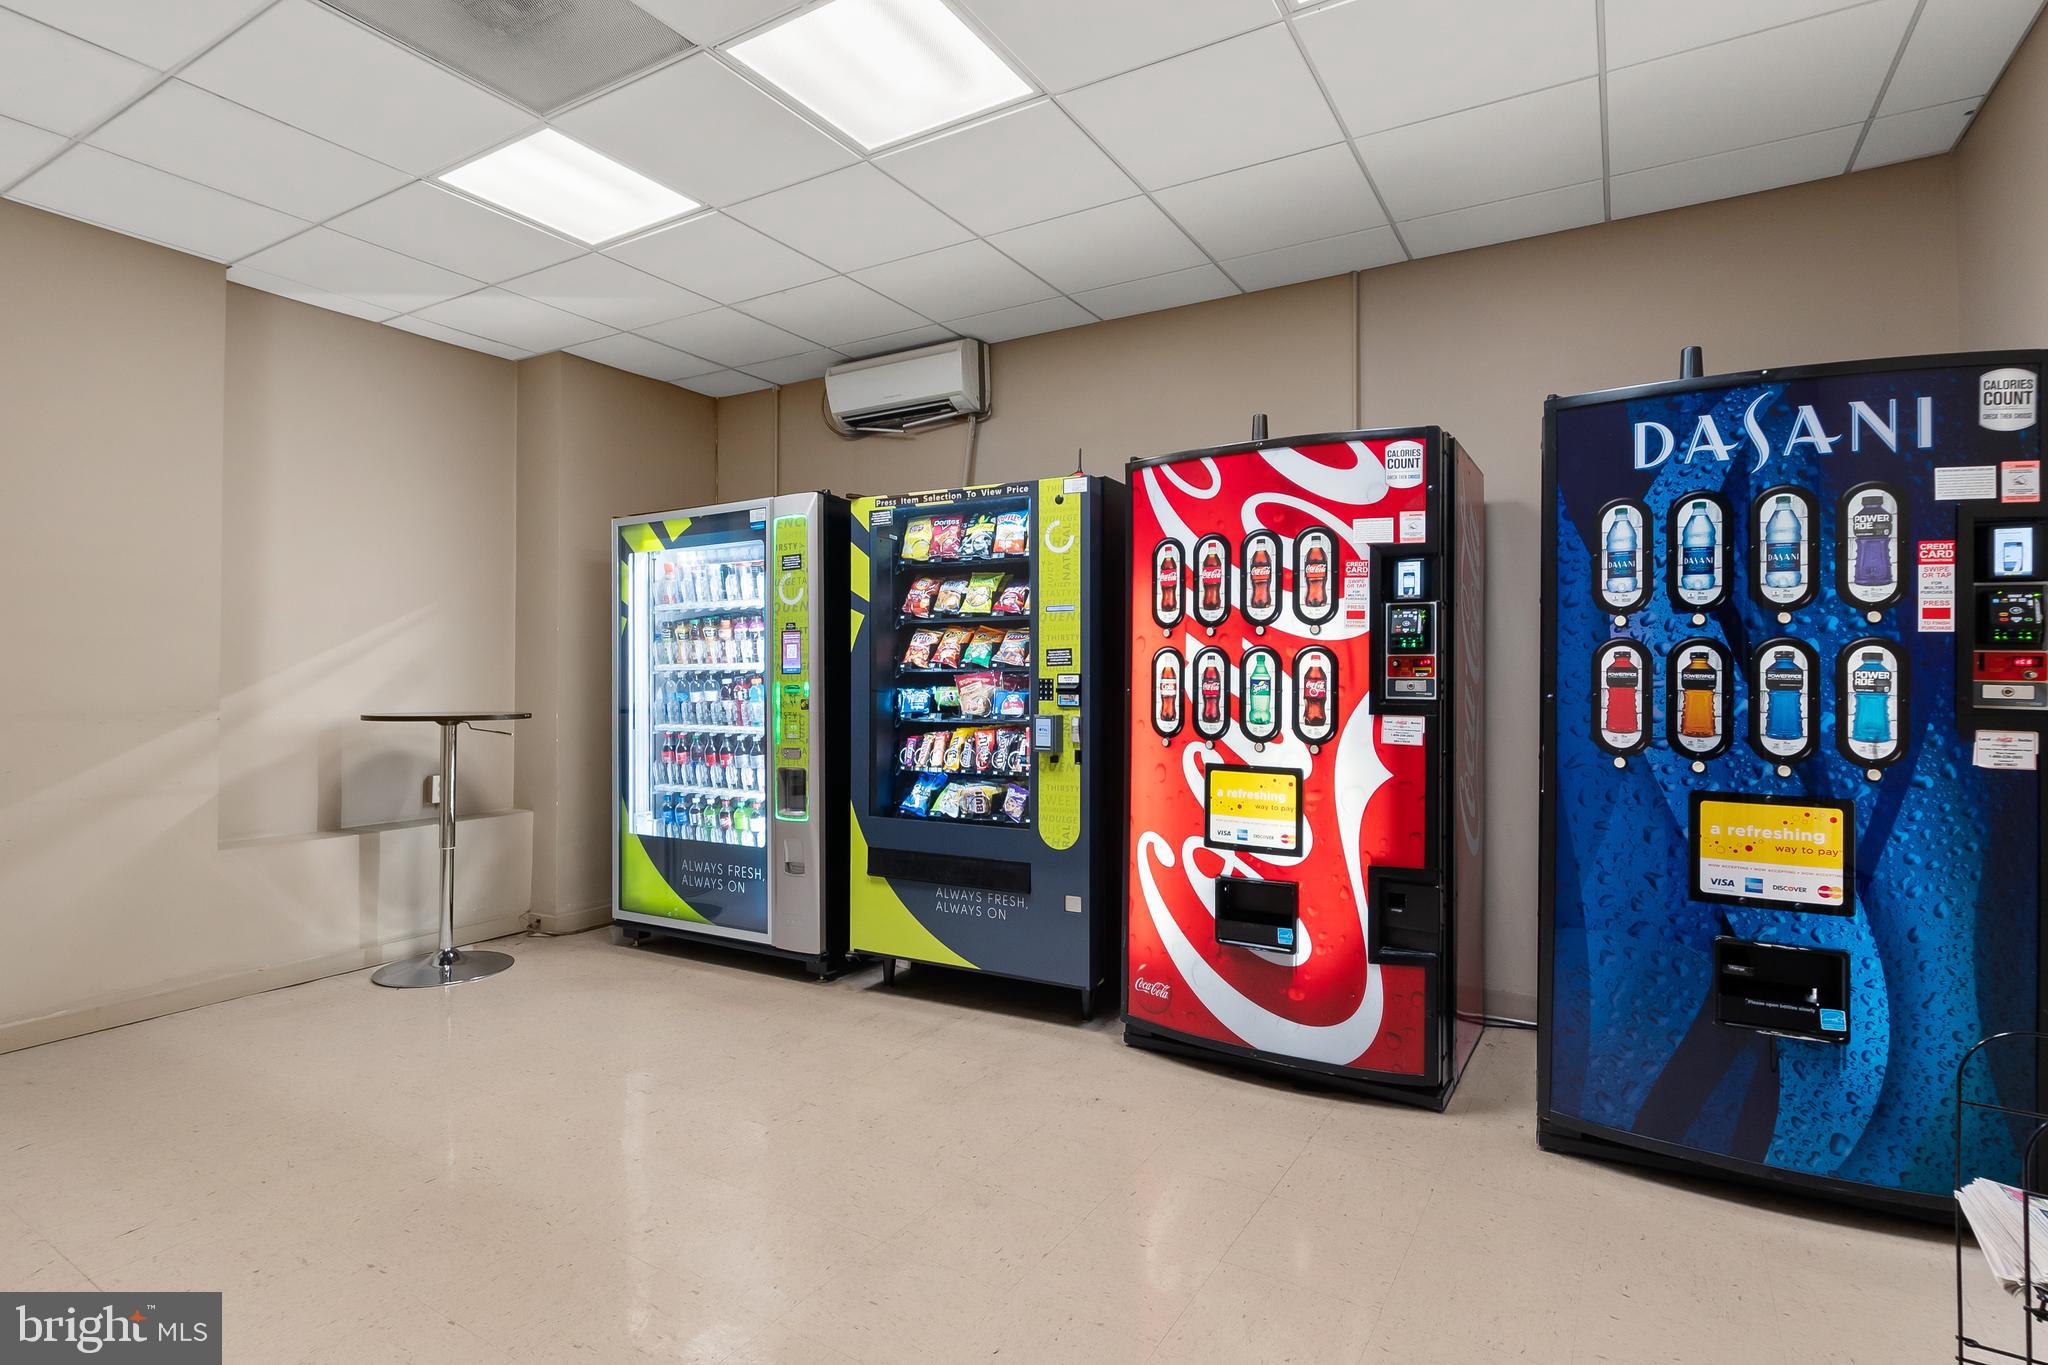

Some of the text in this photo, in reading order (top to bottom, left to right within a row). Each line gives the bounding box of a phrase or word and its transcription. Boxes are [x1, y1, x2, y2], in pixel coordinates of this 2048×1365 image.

[1984, 379, 2033, 390] CALORIES
[1984, 391, 2033, 406] COUNT
[1634, 391, 1932, 474] DASANI
[1387, 449, 1421, 457] CALORIES
[1387, 458, 1421, 469] COUNT
[876, 499, 896, 507] Press
[901, 497, 918, 505] Item
[923, 493, 962, 503] Selection
[981, 489, 1002, 497] View
[1006, 485, 1029, 494] Price
[1854, 514, 1889, 522] POWER
[1684, 556, 1713, 565] DASANI
[1768, 553, 1799, 561] DASANI
[1920, 550, 1954, 559] CARD
[1608, 560, 1635, 569] DASANI
[1855, 671, 1890, 680] POWER
[1217, 788, 1287, 803] a refreshing
[1711, 824, 1826, 845] a refreshing
[1775, 845, 1839, 857] way to pay
[681, 859, 765, 882] ALWAYS FRESH,
[681, 875, 745, 893] ALWAYS ON
[1711, 877, 1735, 887] VISA
[1772, 884, 1807, 893] DISCOVER
[936, 887, 1028, 910] ALWAYS FRESH,
[936, 901, 1006, 920] ALWAYS ON
[1135, 977, 1170, 999] Coca-Cola
